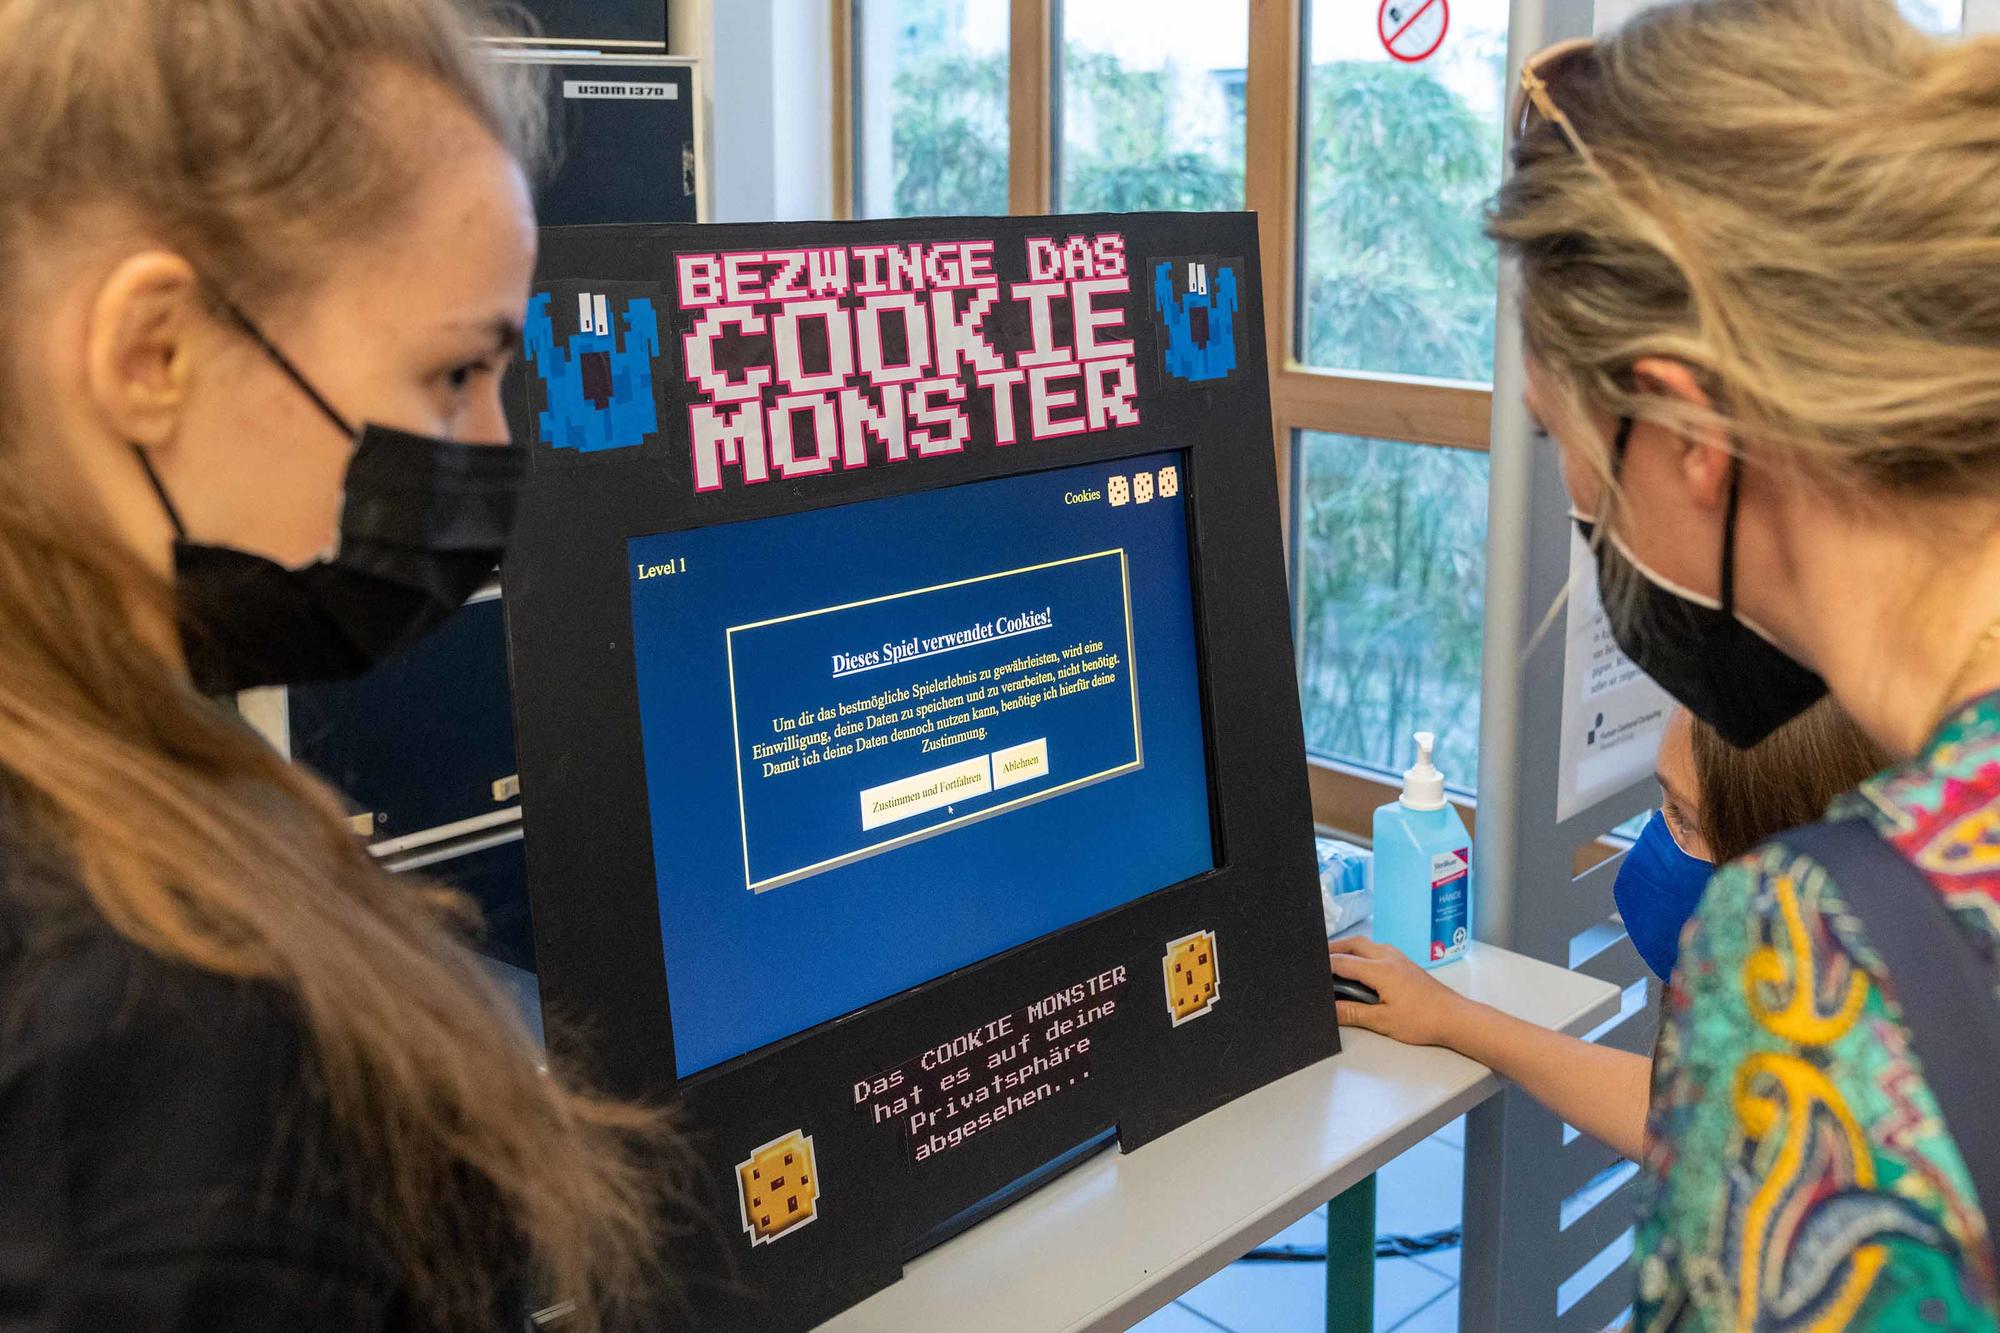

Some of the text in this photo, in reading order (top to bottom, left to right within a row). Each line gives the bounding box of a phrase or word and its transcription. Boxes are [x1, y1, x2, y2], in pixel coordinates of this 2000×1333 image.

[676, 233, 1127, 309] BEZWINGE DAS
[682, 276, 1135, 402] COOKIE
[689, 356, 1141, 492] MONSTER
[1064, 488, 1101, 505] Cookies
[637, 557, 686, 580] Level 1
[773, 640, 1103, 733] Um dir das bestmögliche Spielerlebnis zu gewährleisten, wird eine
[832, 607, 1052, 674] Dieses Spiel verwendet Cookies!
[752, 653, 1120, 760] Einwilligung, deine Daten zu speichern und zu verarbeiten, nicht benötigt.
[763, 673, 1115, 777] Damit ich deine Daten dennoch nutzen kann, benötige ich hierfür deine
[922, 727, 988, 754] Zustimmung.
[872, 772, 982, 813] Zustimmen und Fortfahren
[1002, 755, 1039, 774] Ablehnen
[853, 964, 1127, 1104] Das COOKIE MONSTER
[874, 999, 1116, 1124] hat es auf deine
[910, 1037, 1091, 1135] Privatsphäre
[915, 1069, 1089, 1162] abgesehen...
